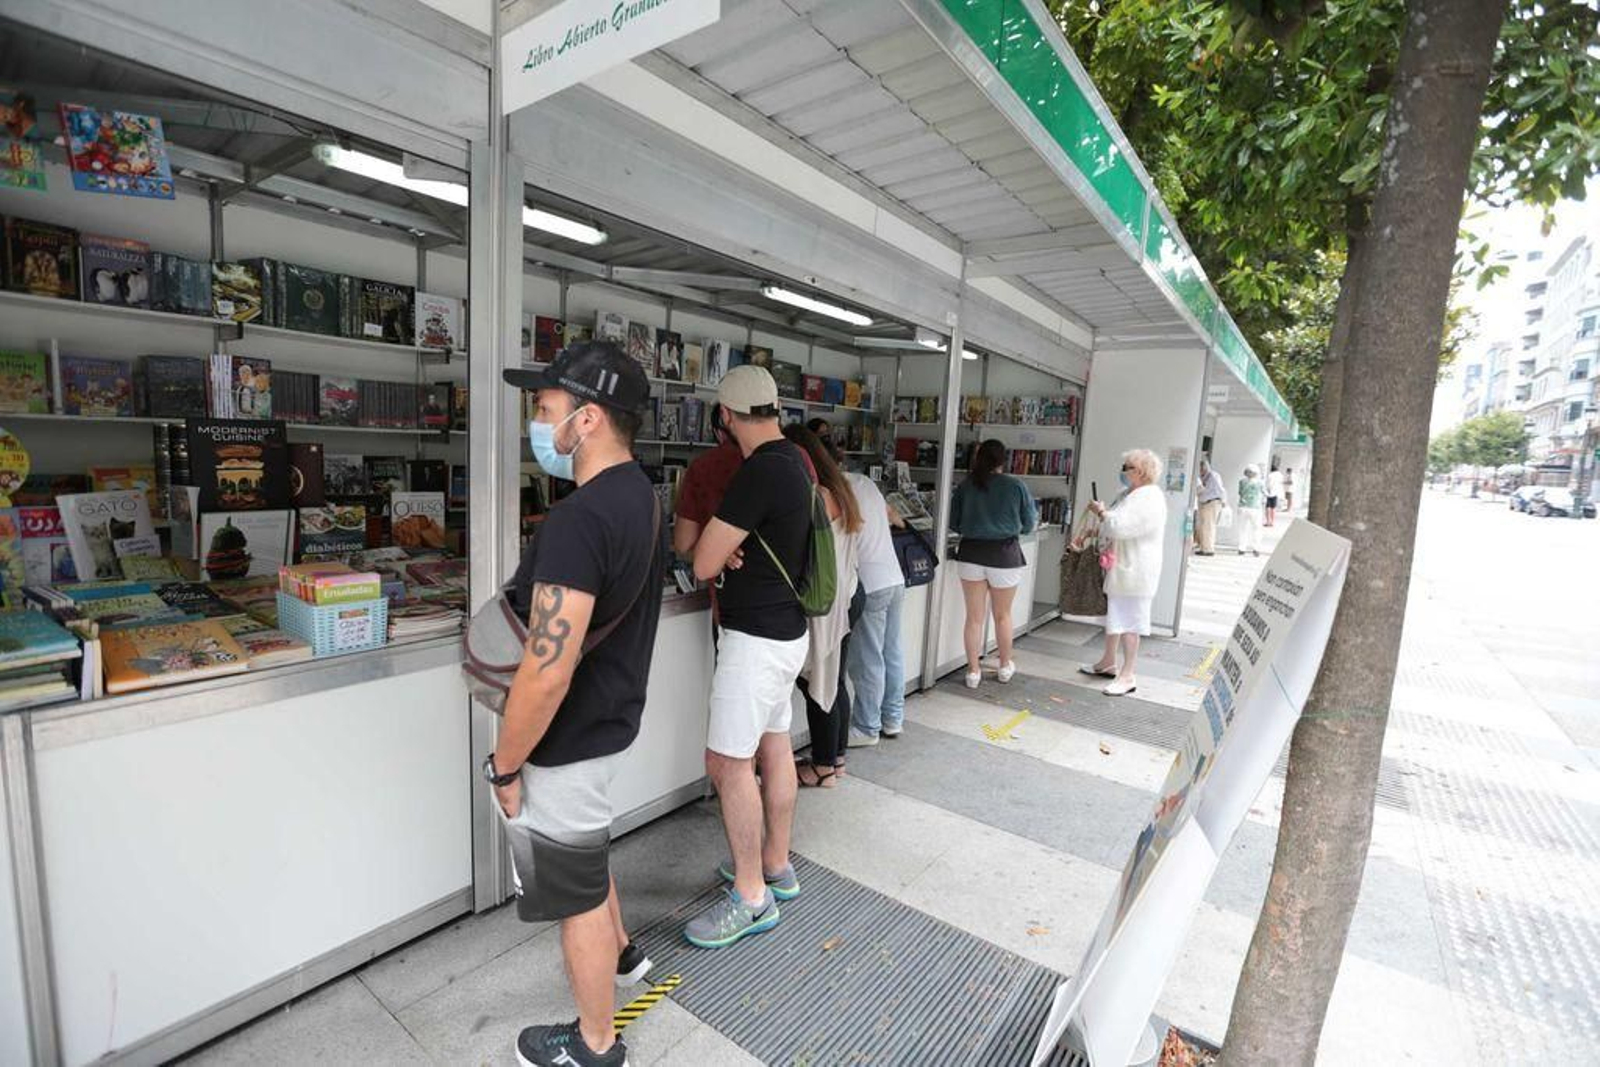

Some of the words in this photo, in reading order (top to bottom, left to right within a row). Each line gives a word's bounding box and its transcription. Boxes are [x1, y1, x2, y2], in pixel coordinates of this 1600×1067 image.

[522, 45, 554, 74] Libro
[557, 18, 607, 55] Abierto
[197, 425, 277, 436] MODERNIST
[211, 433, 265, 443] CUISINE
[77, 500, 139, 516] GATO
[393, 500, 443, 518] QUESO
